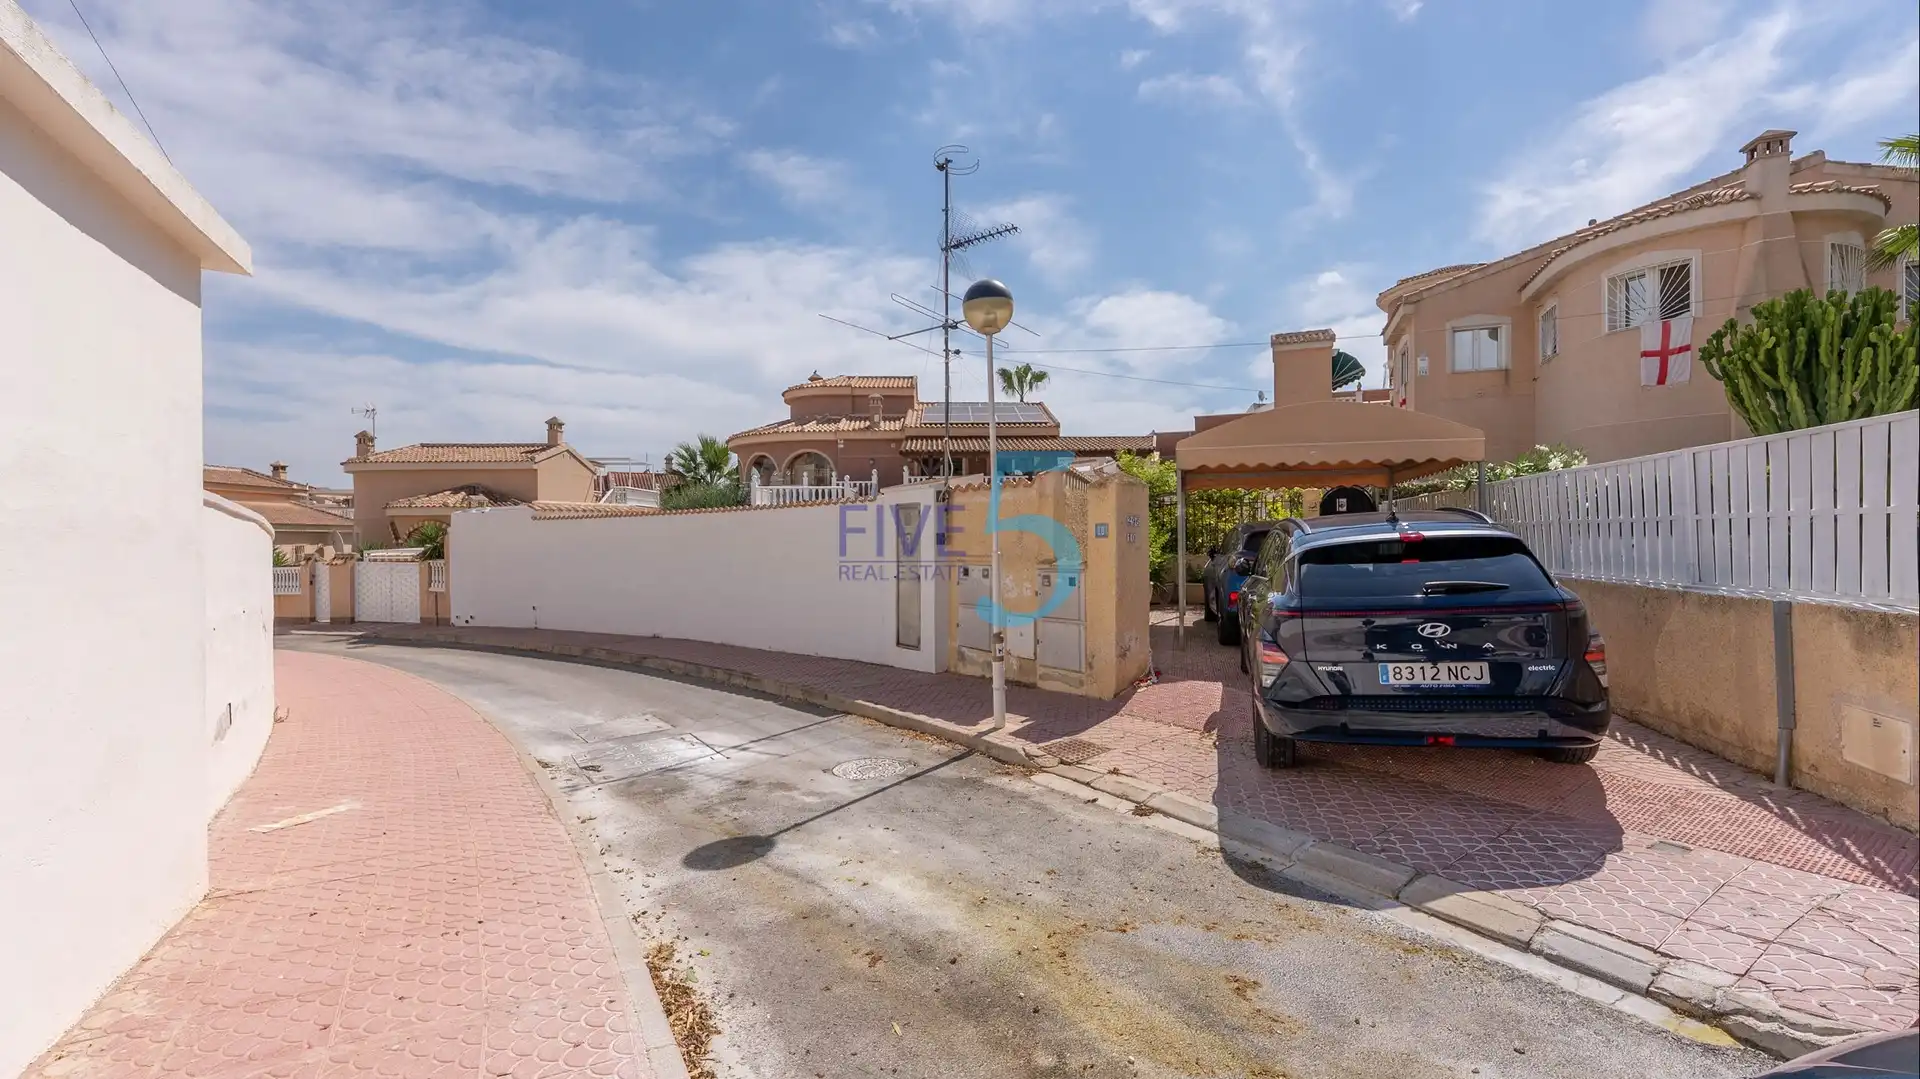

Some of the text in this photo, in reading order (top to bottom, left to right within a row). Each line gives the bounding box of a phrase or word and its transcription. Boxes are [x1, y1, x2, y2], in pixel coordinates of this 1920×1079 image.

[1376, 642, 1494, 650] KONA
[1392, 665, 1441, 681] 8312
[1447, 665, 1484, 681] NCJ
